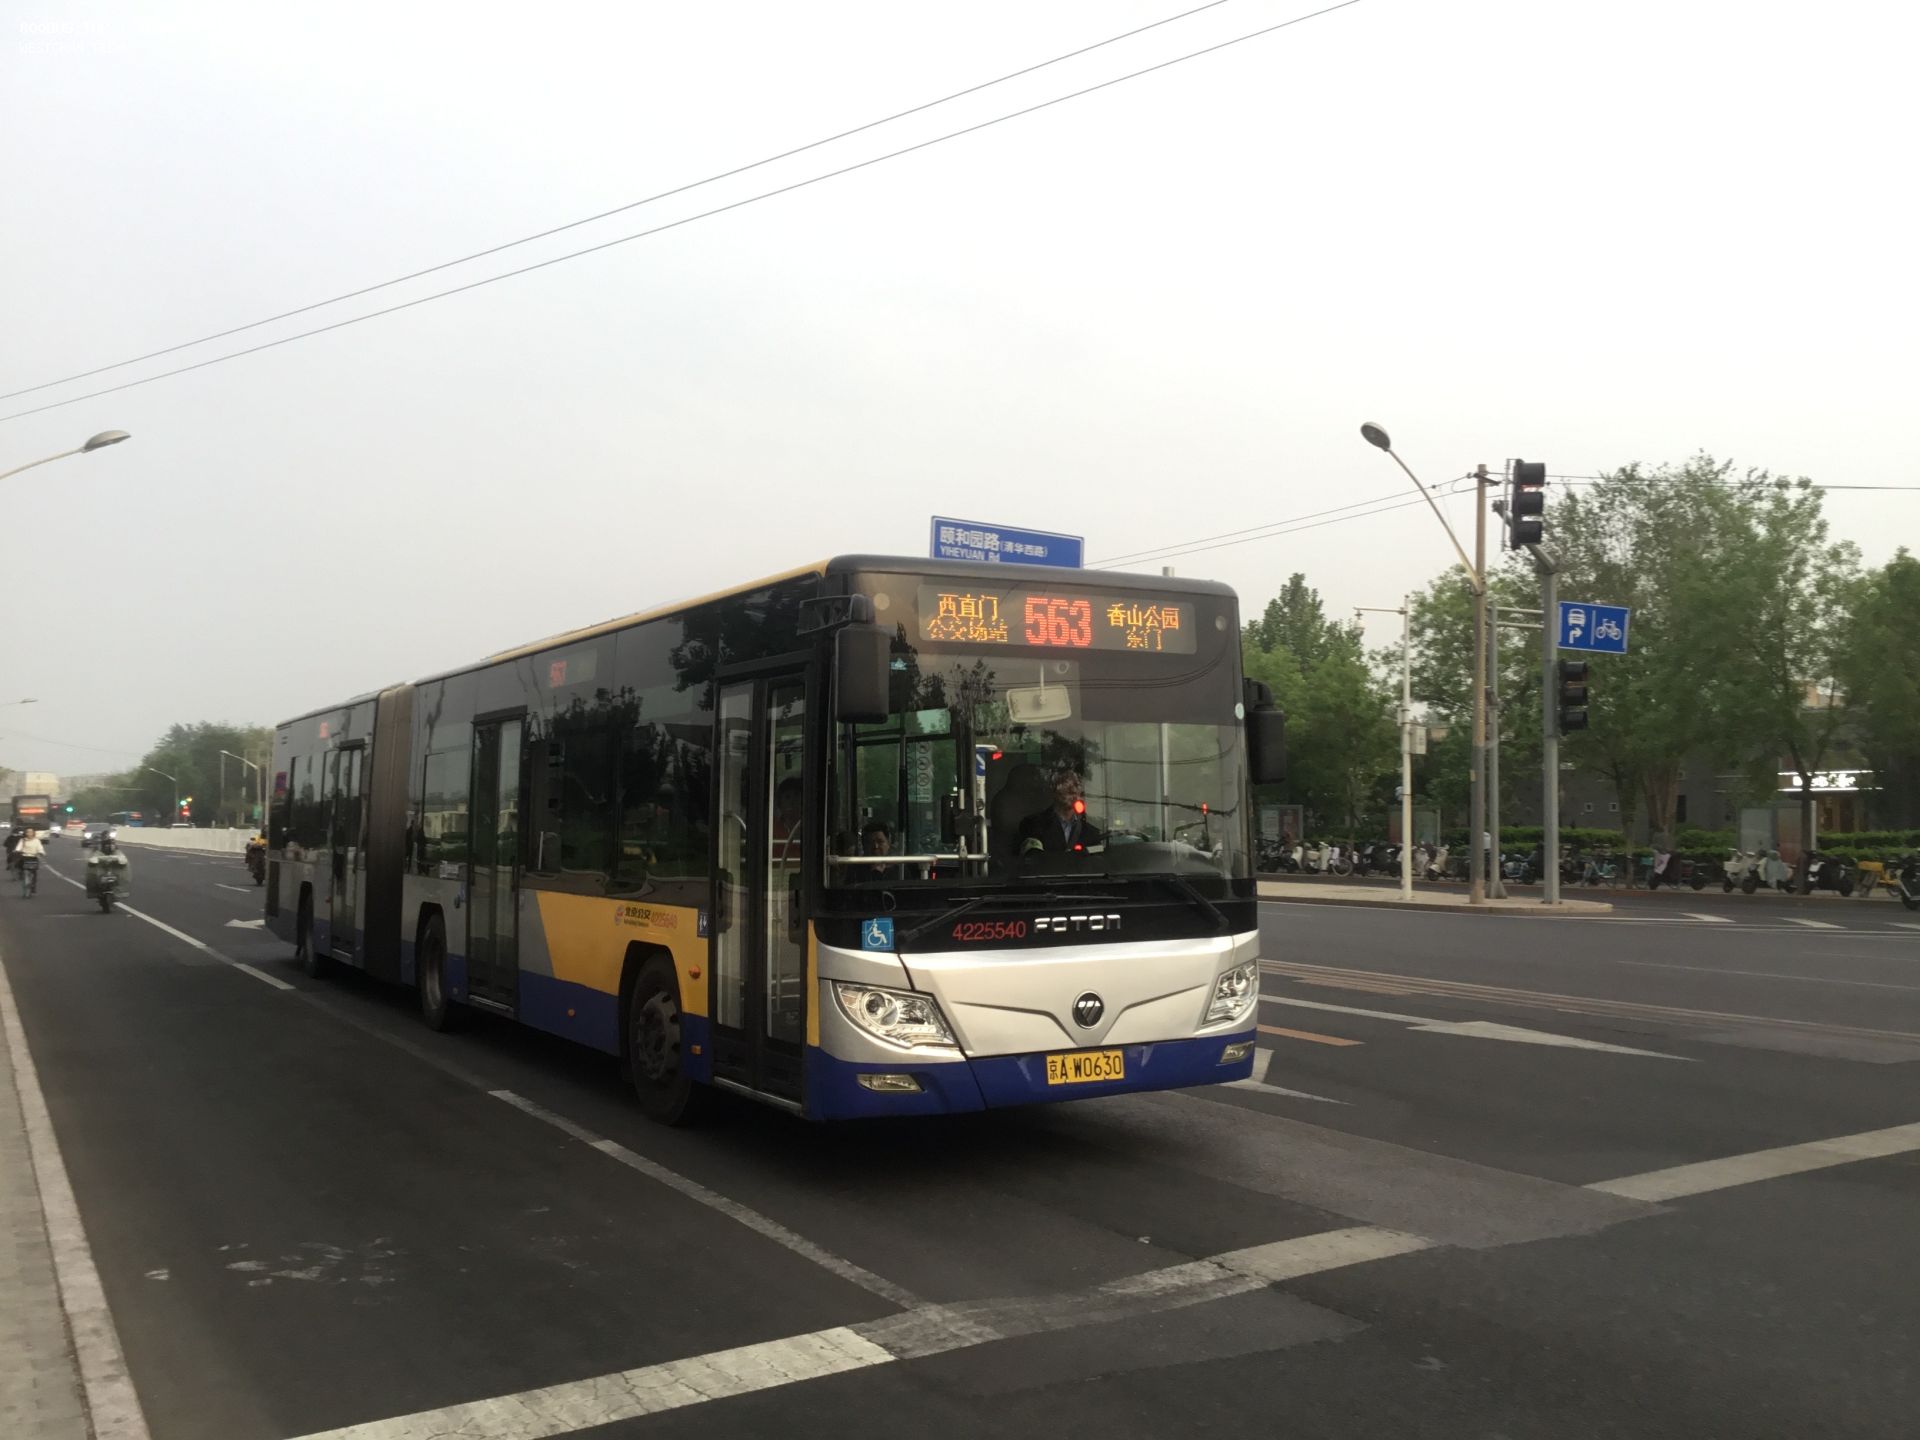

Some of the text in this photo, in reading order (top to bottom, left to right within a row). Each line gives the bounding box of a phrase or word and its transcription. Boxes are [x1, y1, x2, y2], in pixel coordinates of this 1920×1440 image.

[940, 526, 1000, 551] 颐和园路
[940, 545, 985, 561] YIHEYUAN
[936, 593, 998, 621] 西直门
[1106, 603, 1180, 630] 香山公园
[926, 617, 1008, 643] 公交场站
[1024, 596, 1092, 647] 563
[1126, 626, 1163, 650] 东门
[952, 921, 1027, 941] 4225540
[1034, 913, 1121, 934] FOTON
